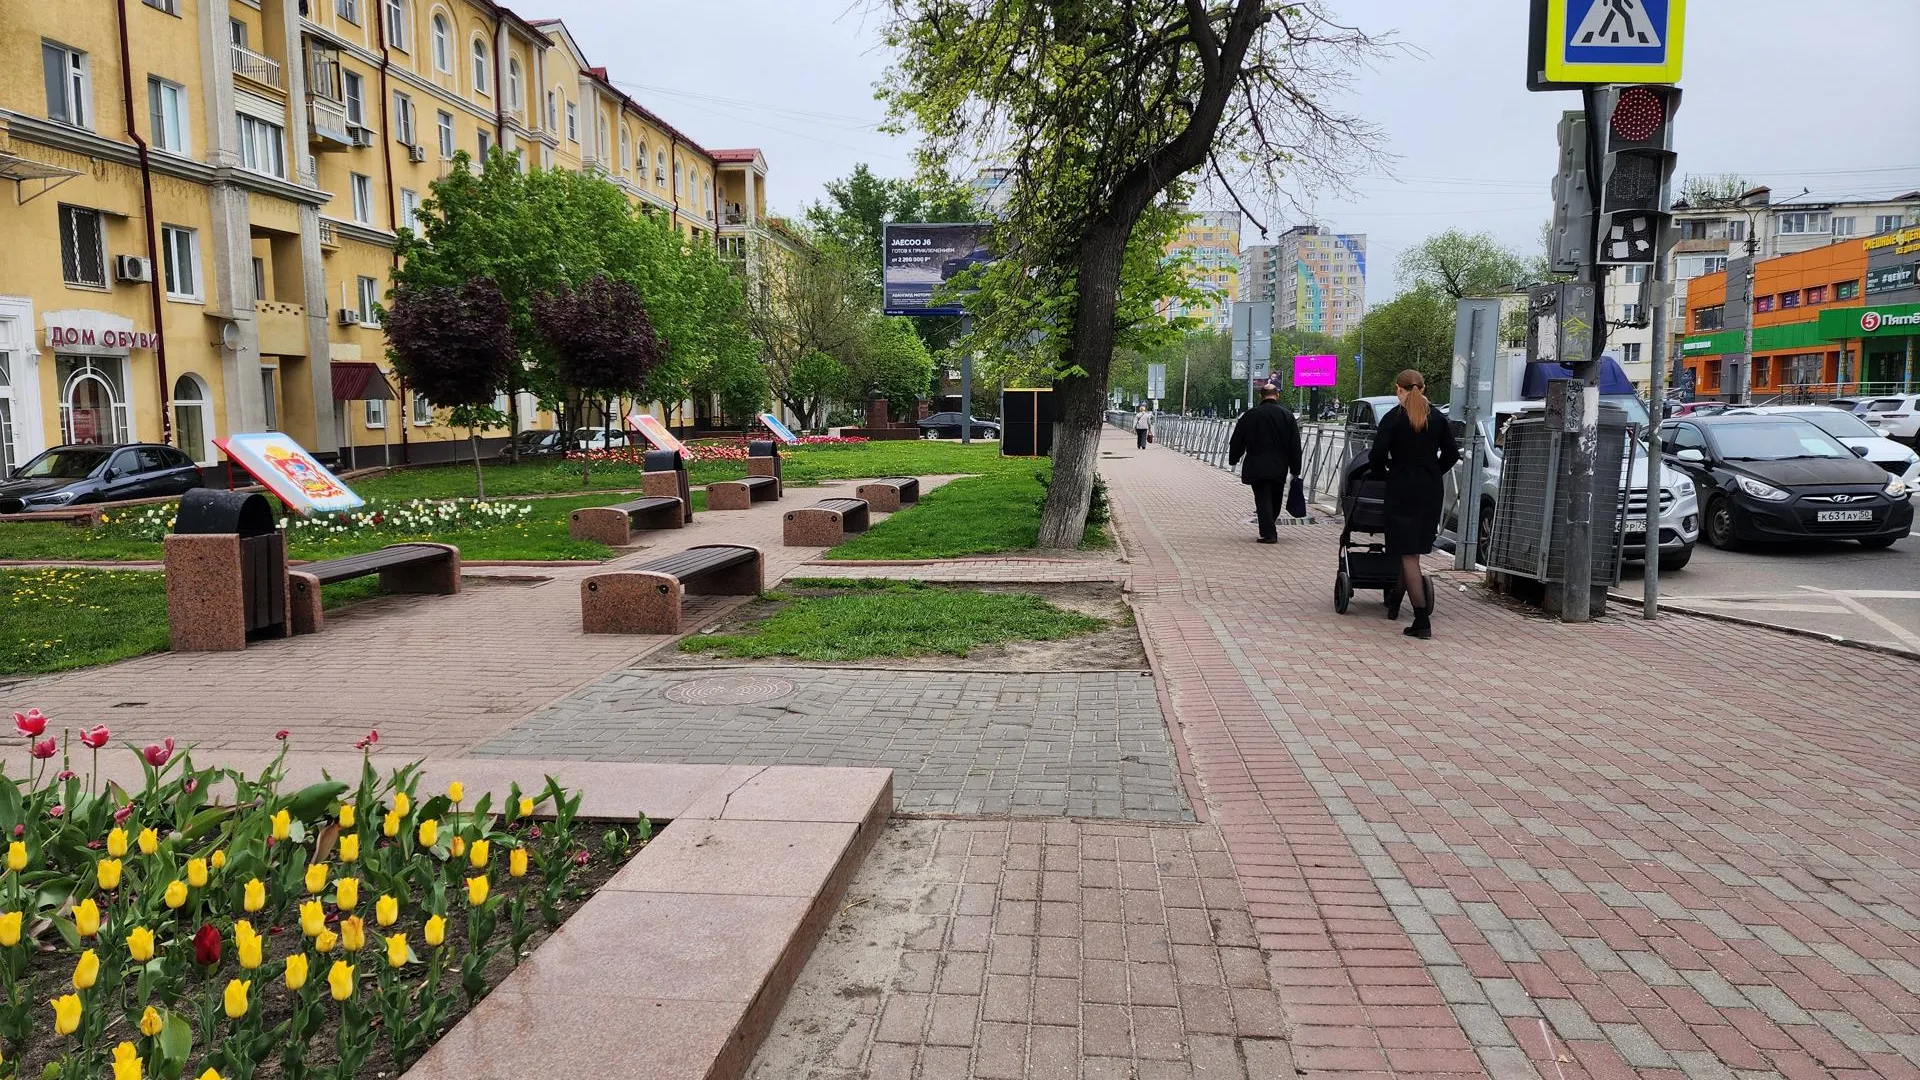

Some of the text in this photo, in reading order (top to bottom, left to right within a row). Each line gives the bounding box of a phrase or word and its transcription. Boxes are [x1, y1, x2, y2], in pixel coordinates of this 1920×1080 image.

[1865, 313, 1875, 328] 5
[52, 326, 160, 349] ДОМ ОБУВИ
